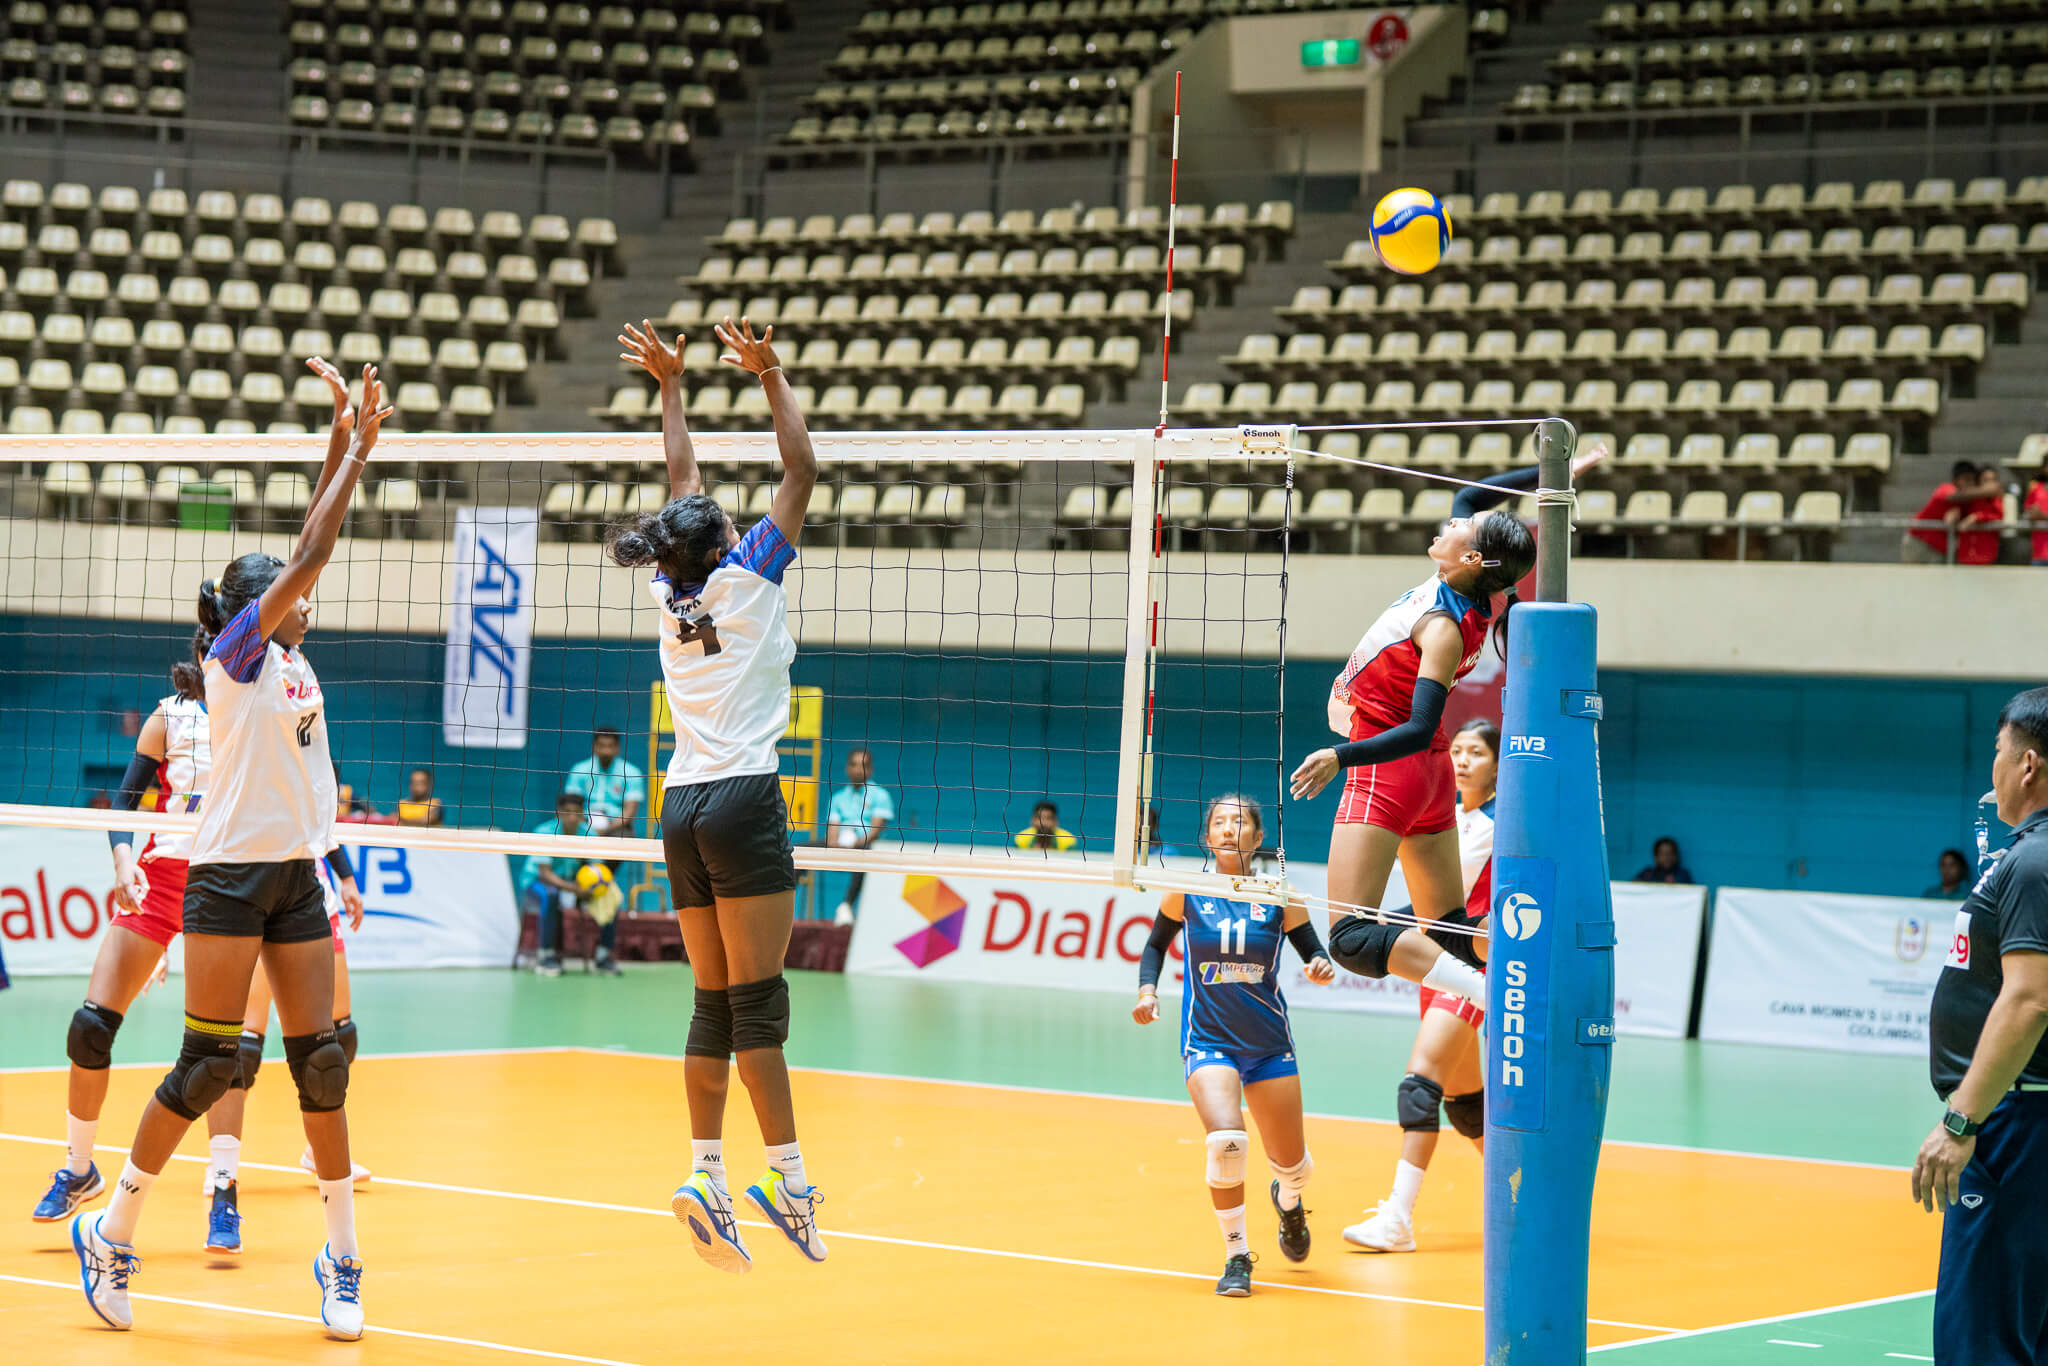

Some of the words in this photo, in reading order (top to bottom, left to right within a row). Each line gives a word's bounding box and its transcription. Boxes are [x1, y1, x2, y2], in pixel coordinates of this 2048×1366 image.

[1251, 429, 1281, 438] Senoh
[1509, 735, 1546, 752] FIVB
[0, 867, 117, 942] alo
[1216, 917, 1247, 956] 11
